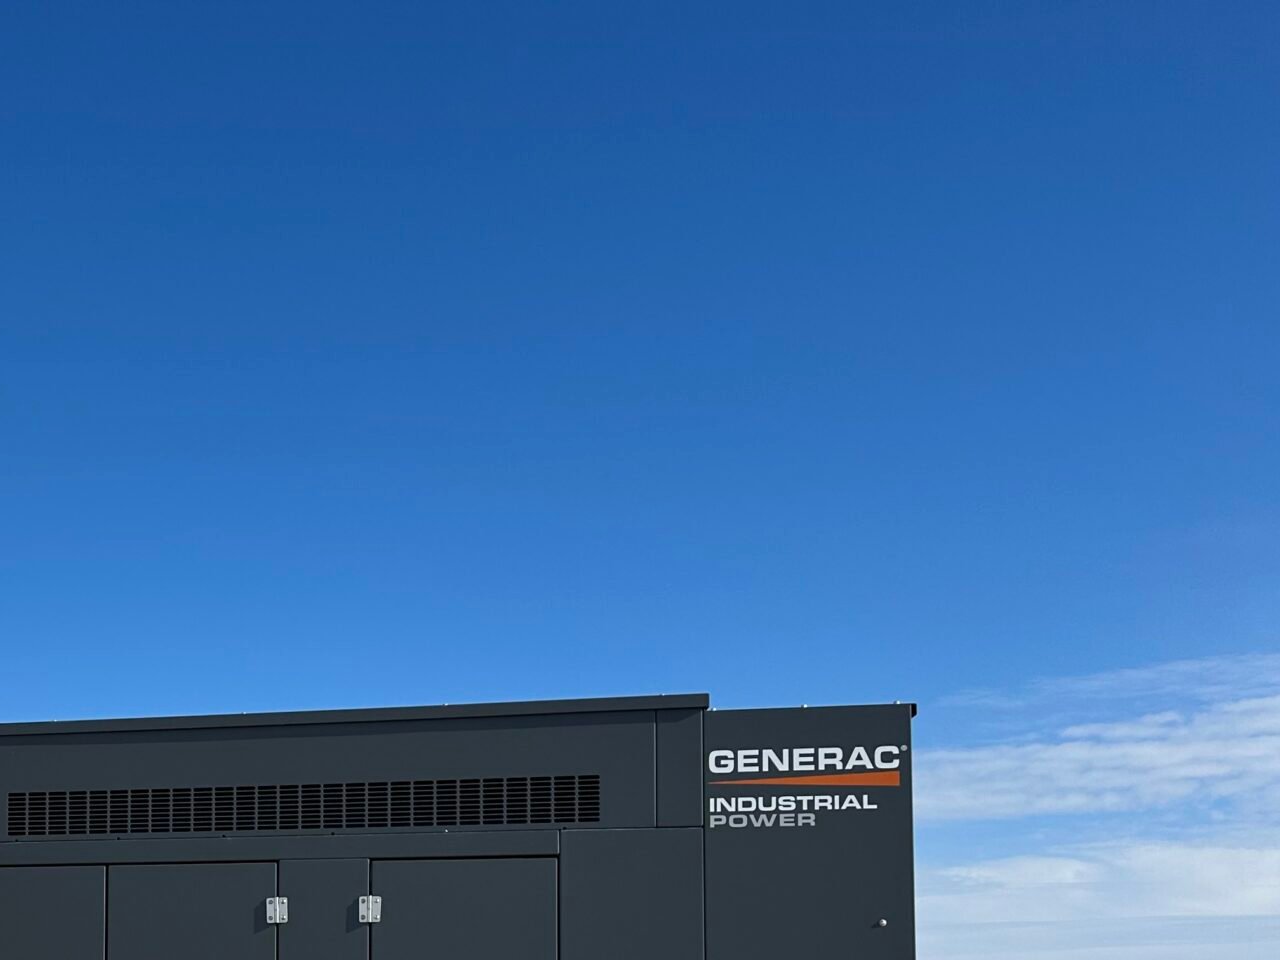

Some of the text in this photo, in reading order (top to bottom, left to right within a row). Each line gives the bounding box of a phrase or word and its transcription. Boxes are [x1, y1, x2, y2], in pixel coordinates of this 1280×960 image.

[708, 745, 900, 774] GENERAC
[709, 794, 878, 812] INDUSTRIAL
[709, 813, 816, 828] POWER
